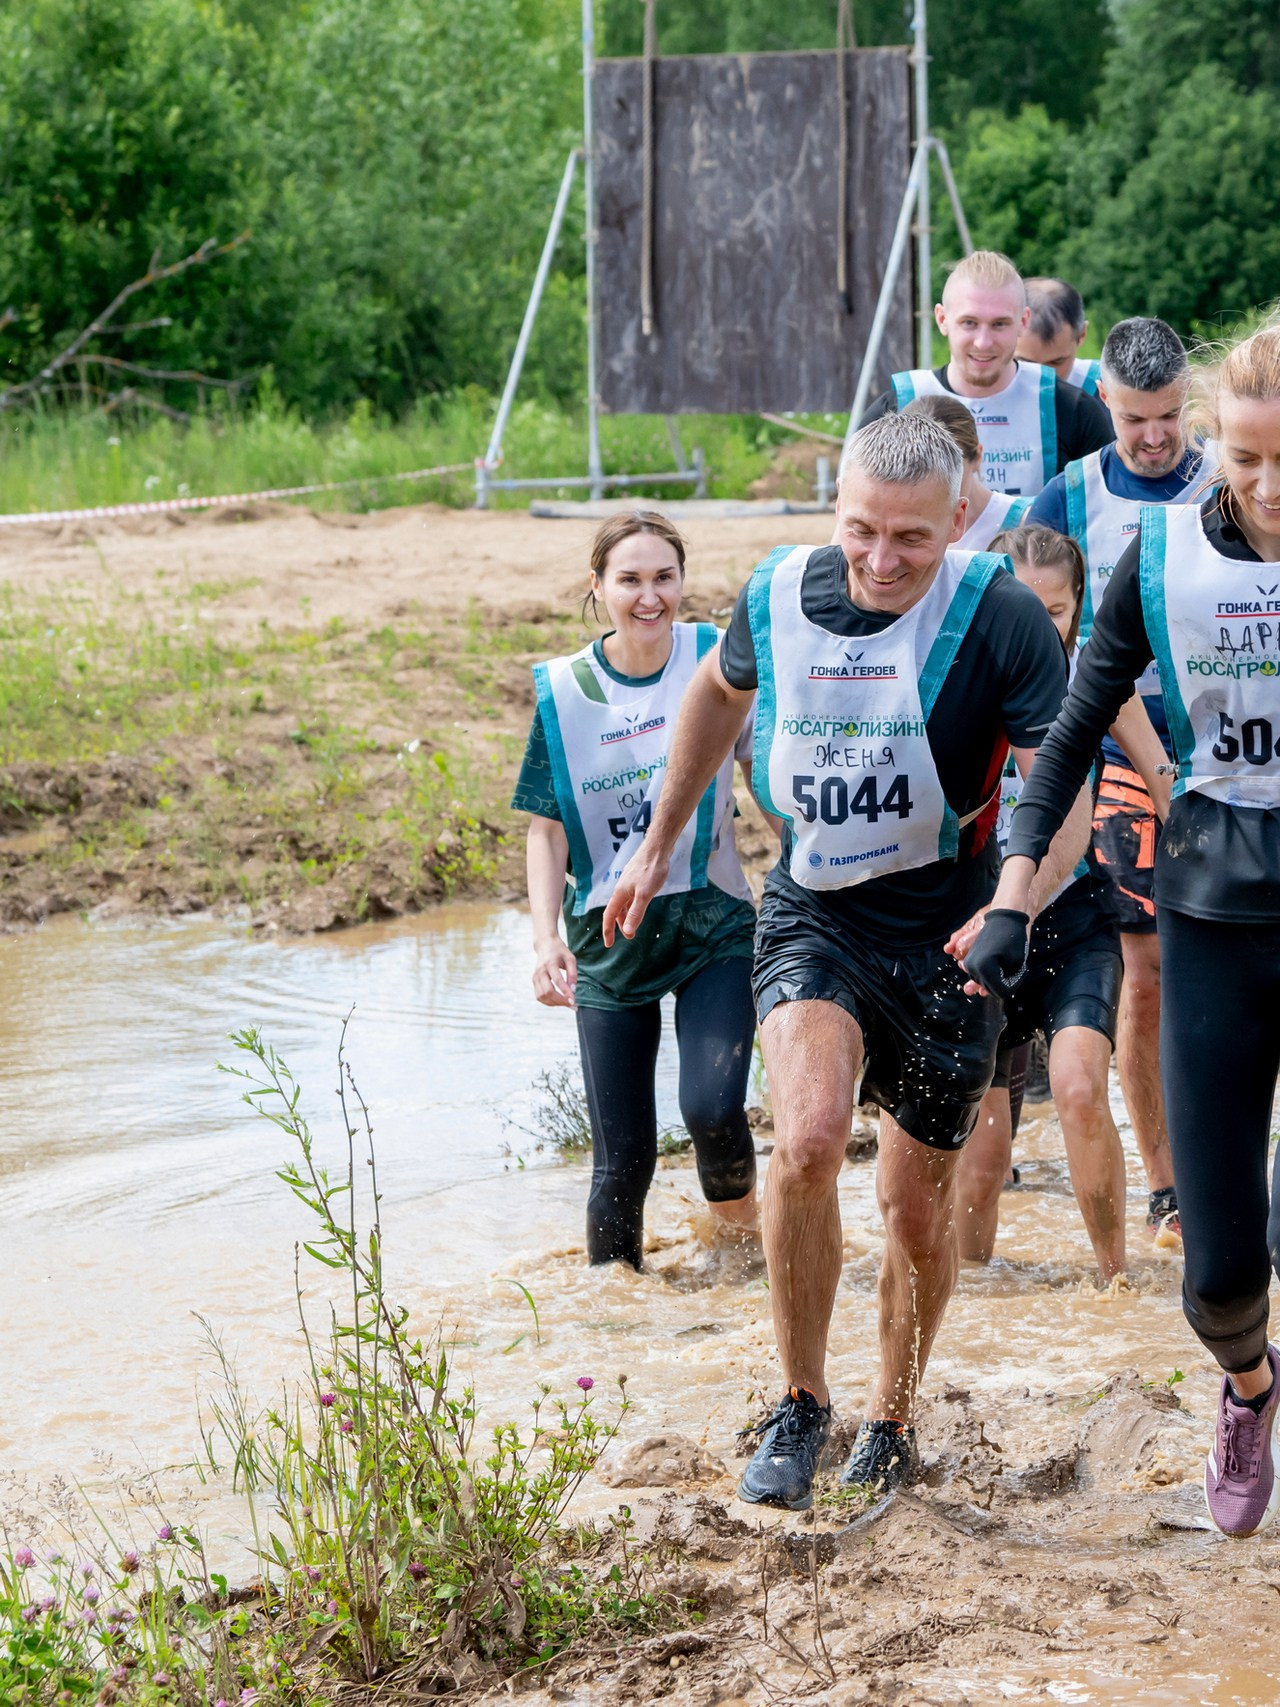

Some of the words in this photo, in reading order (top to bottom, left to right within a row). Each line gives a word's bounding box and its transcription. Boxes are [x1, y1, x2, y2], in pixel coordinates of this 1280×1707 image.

[976, 415, 1008, 423] ГЕРОЕВ
[1217, 602, 1263, 614] ГОНКА
[811, 666, 849, 676] ГОНКА
[852, 665, 896, 676] ГЕРОЕВ
[601, 728, 632, 743] ГОНКА
[633, 715, 666, 734] ГЕРОЕВ
[781, 720, 926, 737] РОСАГРОЛИЗИНГ
[813, 742, 896, 768] ЖЕНЯ
[792, 774, 914, 826] 5044
[829, 843, 900, 866] ГАЗПРОМБАНК
